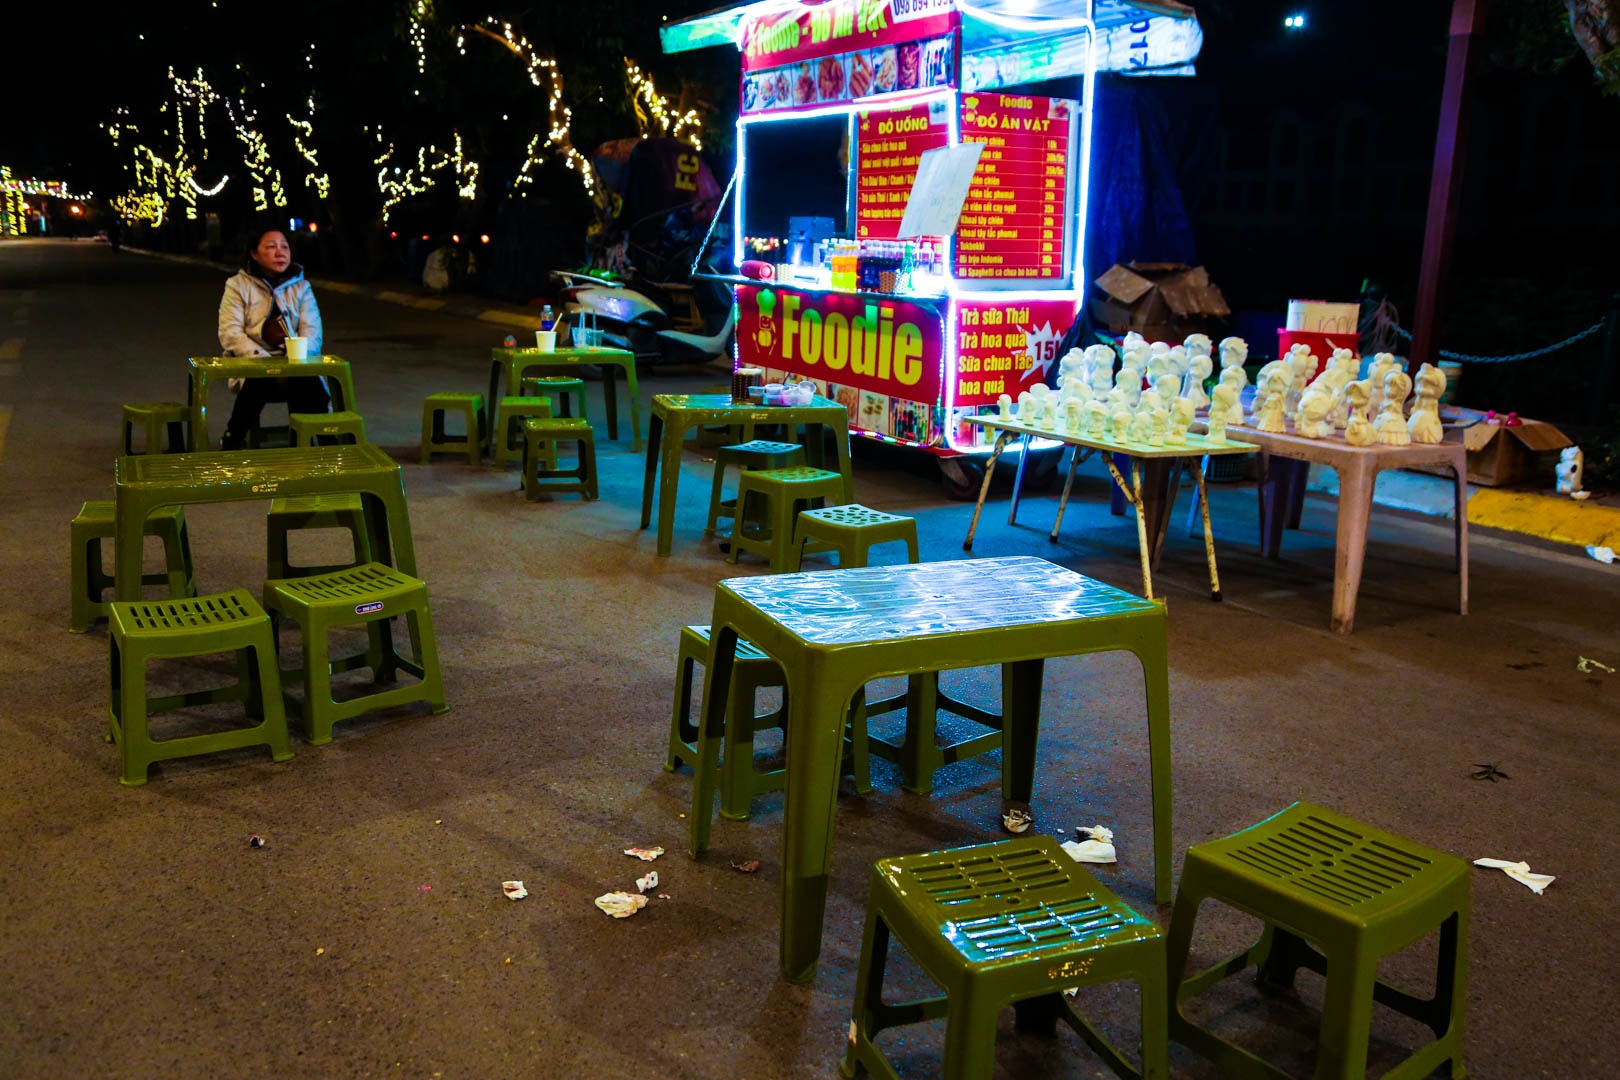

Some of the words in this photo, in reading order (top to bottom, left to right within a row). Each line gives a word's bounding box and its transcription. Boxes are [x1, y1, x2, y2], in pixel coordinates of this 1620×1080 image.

[1000, 95, 1033, 109] Foodie
[675, 153, 699, 191] FC
[961, 307, 979, 326] Trà
[982, 307, 1003, 325] sữa
[1005, 307, 1029, 324] Thái
[782, 294, 923, 386] Foodie
[960, 331, 978, 349] Trà
[981, 332, 1002, 348] hoa
[1005, 328, 1026, 349] quả
[958, 355, 980, 373] Sữa
[983, 355, 1012, 371] chua
[959, 378, 980, 396] hoa
[983, 375, 1004, 396] quả
